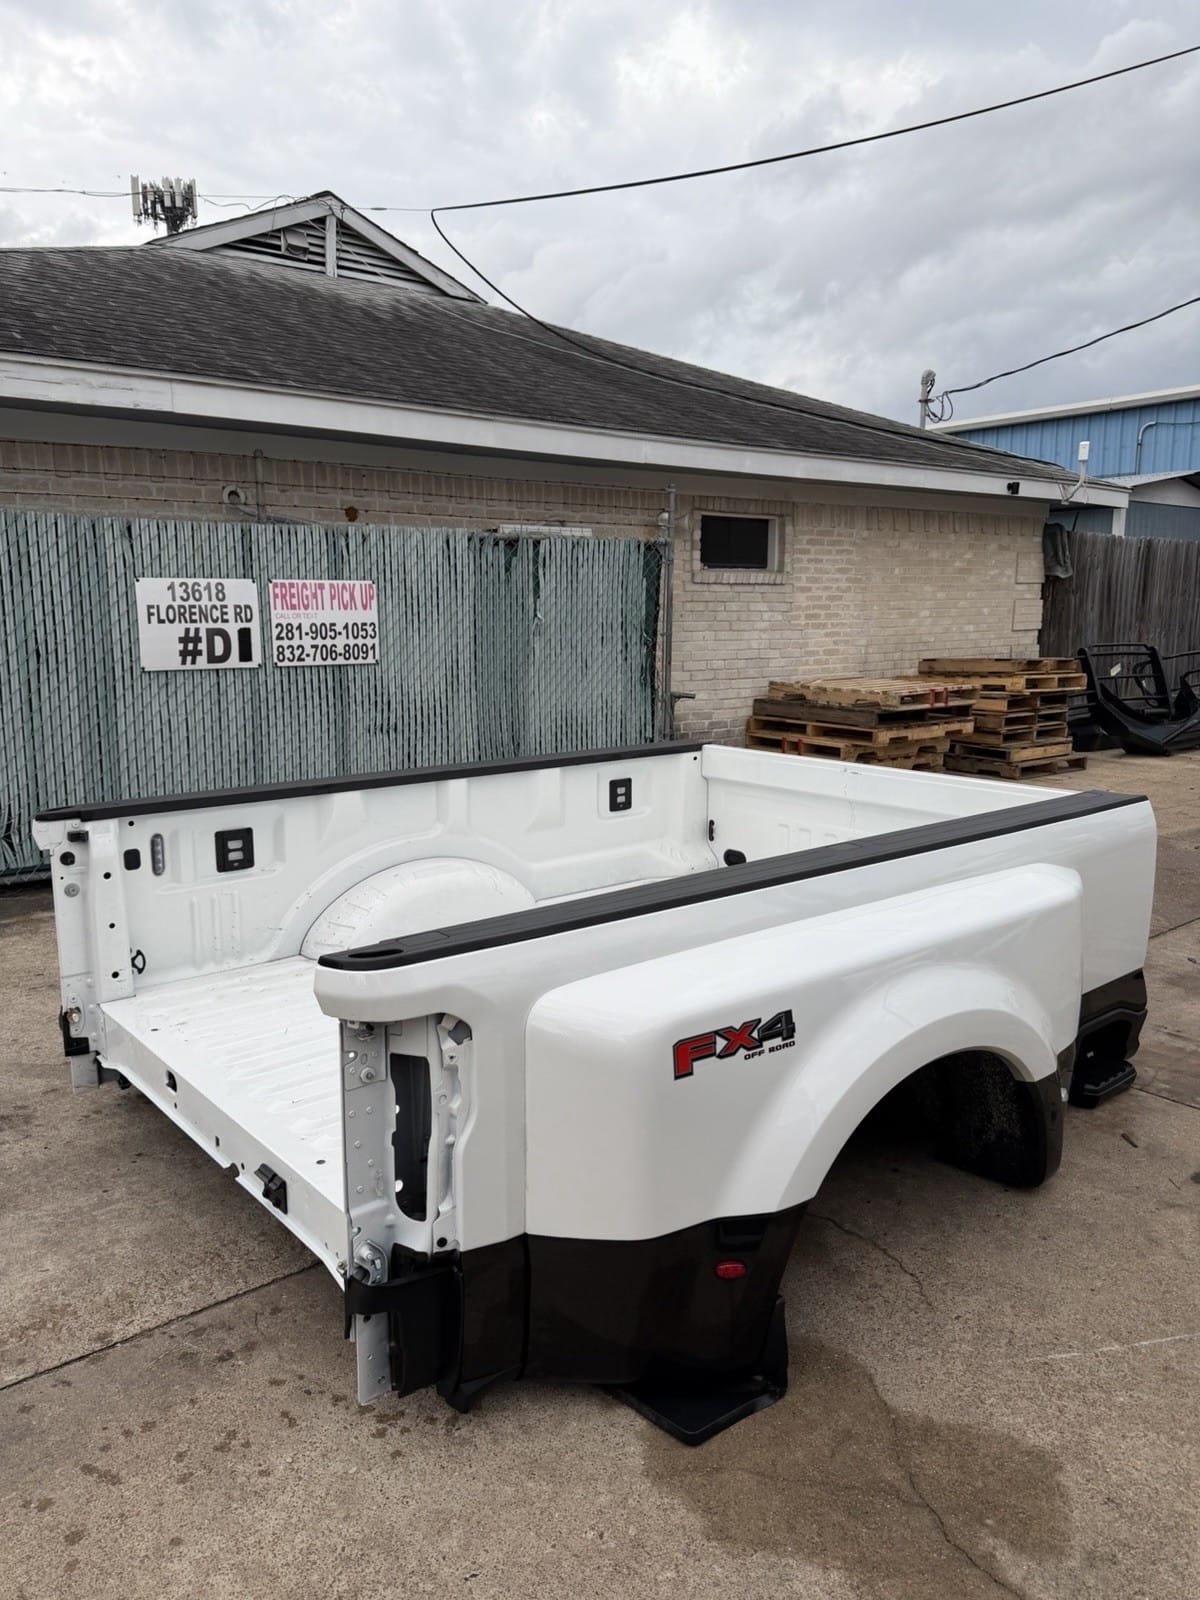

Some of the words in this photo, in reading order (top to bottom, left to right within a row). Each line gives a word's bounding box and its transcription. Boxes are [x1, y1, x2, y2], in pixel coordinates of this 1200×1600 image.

[167, 582, 226, 602] 13618
[272, 583, 325, 610] FREIGHT
[330, 584, 357, 610] PICK
[360, 583, 374, 610] UP
[147, 604, 229, 624] FLORENCE
[234, 604, 253, 623] RD
[275, 622, 377, 640] 281-905-1053
[276, 643, 377, 662] 832-706-8091
[673, 1009, 796, 1081] FX4
[744, 1049, 765, 1060] OFF
[768, 1040, 795, 1053] ROAD
